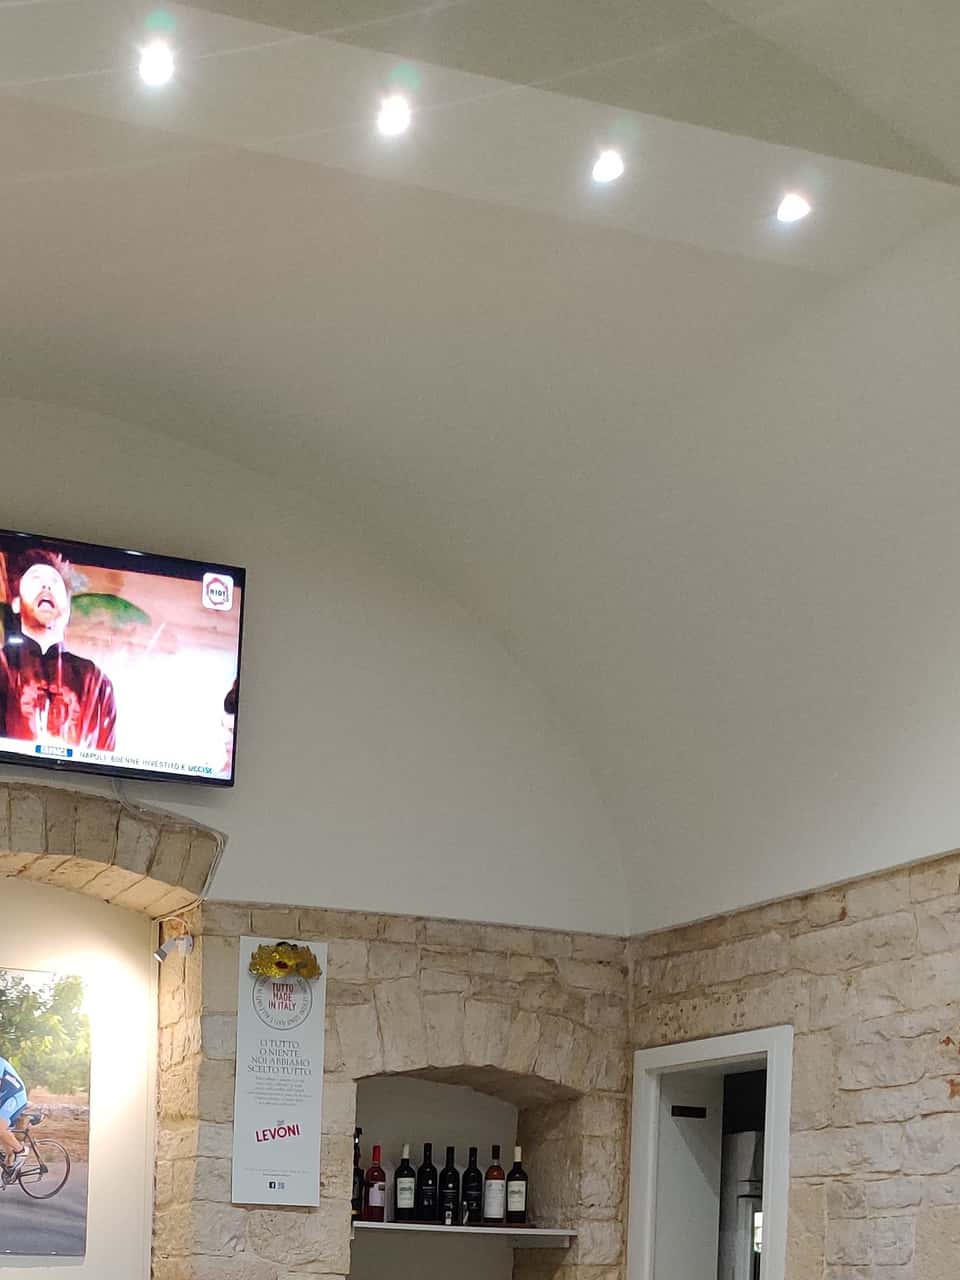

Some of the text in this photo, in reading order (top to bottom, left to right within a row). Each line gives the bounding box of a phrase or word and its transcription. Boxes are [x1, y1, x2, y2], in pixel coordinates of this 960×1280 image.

[271, 982, 294, 993] TUTTO
[272, 991, 293, 1002] MADE
[268, 1000, 297, 1012] IN ITALY
[269, 1039, 300, 1049] TUTTO
[268, 1048, 300, 1058] NIENTE
[251, 1056, 311, 1068] NOI ABBIAMO
[247, 1065, 313, 1076] SCELTO TUTTO
[255, 1124, 301, 1143] LEVONI
